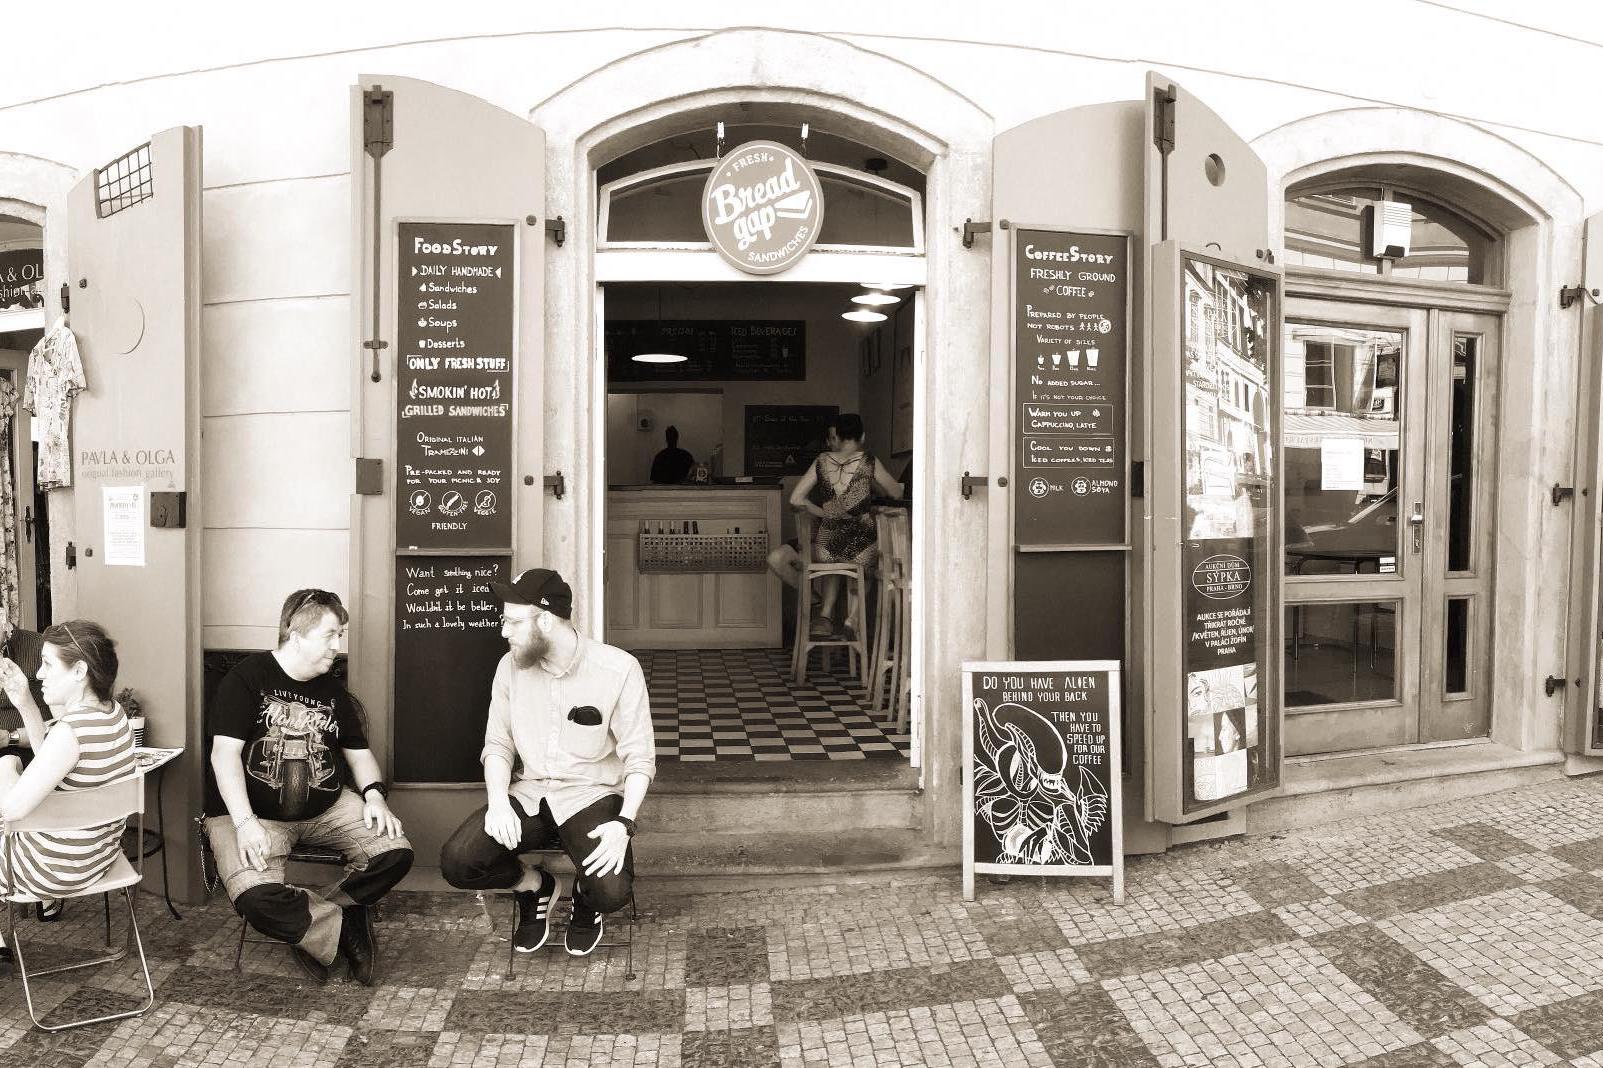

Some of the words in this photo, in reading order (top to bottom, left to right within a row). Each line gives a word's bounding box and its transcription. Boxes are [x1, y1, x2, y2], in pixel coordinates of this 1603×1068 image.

[733, 152, 768, 172] FRESH
[710, 157, 800, 224] Bread
[734, 205, 775, 250] gap
[748, 226, 808, 262] SANDWICHES
[7, 266, 16, 282] &
[420, 266, 447, 276] DAILY
[451, 266, 494, 277] HANDMADE
[1030, 268, 1072, 280] FRESHLY
[1078, 272, 1116, 282] GROUND
[428, 281, 478, 294] Sandwiches
[1056, 286, 1086, 297] COFFEE
[429, 299, 457, 310] Salads
[1026, 304, 1062, 318] PREPARED
[428, 318, 457, 333] Soups
[427, 337, 465, 349] Desserts
[1037, 334, 1062, 344] VARIETY
[409, 358, 440, 370] ONLY
[445, 358, 475, 370] FRESH
[476, 358, 506, 370] STUFF
[1032, 376, 1043, 385] NO
[419, 385, 468, 399] SMOKIN'
[470, 387, 492, 399] HOT
[405, 405, 444, 417] GRILLED
[449, 405, 505, 417] SANDWICHES
[1028, 408, 1051, 417] WARM
[416, 432, 452, 443] ORIGINAL
[456, 435, 484, 443] ITALIAN
[1030, 440, 1052, 451] COOL
[81, 450, 118, 466] PAVLA
[122, 450, 130, 465] &
[136, 450, 176, 465] OLGA
[1092, 480, 1118, 488] ALMOND
[431, 522, 468, 530] FRIENDLY
[406, 566, 435, 578] Want
[407, 583, 429, 596] Come
[434, 585, 449, 597] get
[455, 584, 464, 593] it
[445, 600, 454, 611] it
[457, 600, 466, 611] be
[1197, 612, 1217, 621] AUKCE
[1217, 611, 1224, 619] SE
[402, 620, 411, 630] In
[415, 618, 431, 628] such
[442, 616, 465, 630] lovely
[1217, 647, 1236, 655] PRAHA
[983, 676, 997, 690] DO
[1003, 676, 1024, 689] YOU
[1031, 677, 1054, 689] HAVE
[1064, 677, 1096, 689] ALIEN
[1003, 692, 1033, 702] BEHIND
[1038, 692, 1060, 702] YOUR
[1065, 691, 1088, 701] BACK
[1051, 711, 1076, 722] THEN
[1080, 712, 1098, 722] YOU
[1070, 724, 1090, 733] HAVE
[1092, 723, 1101, 733] TO
[1067, 734, 1093, 745] SPEED
[1096, 736, 1106, 744] UP
[1074, 744, 1088, 754] FOR
[1090, 744, 1105, 754] OUR
[1073, 754, 1101, 764] COFFEE
